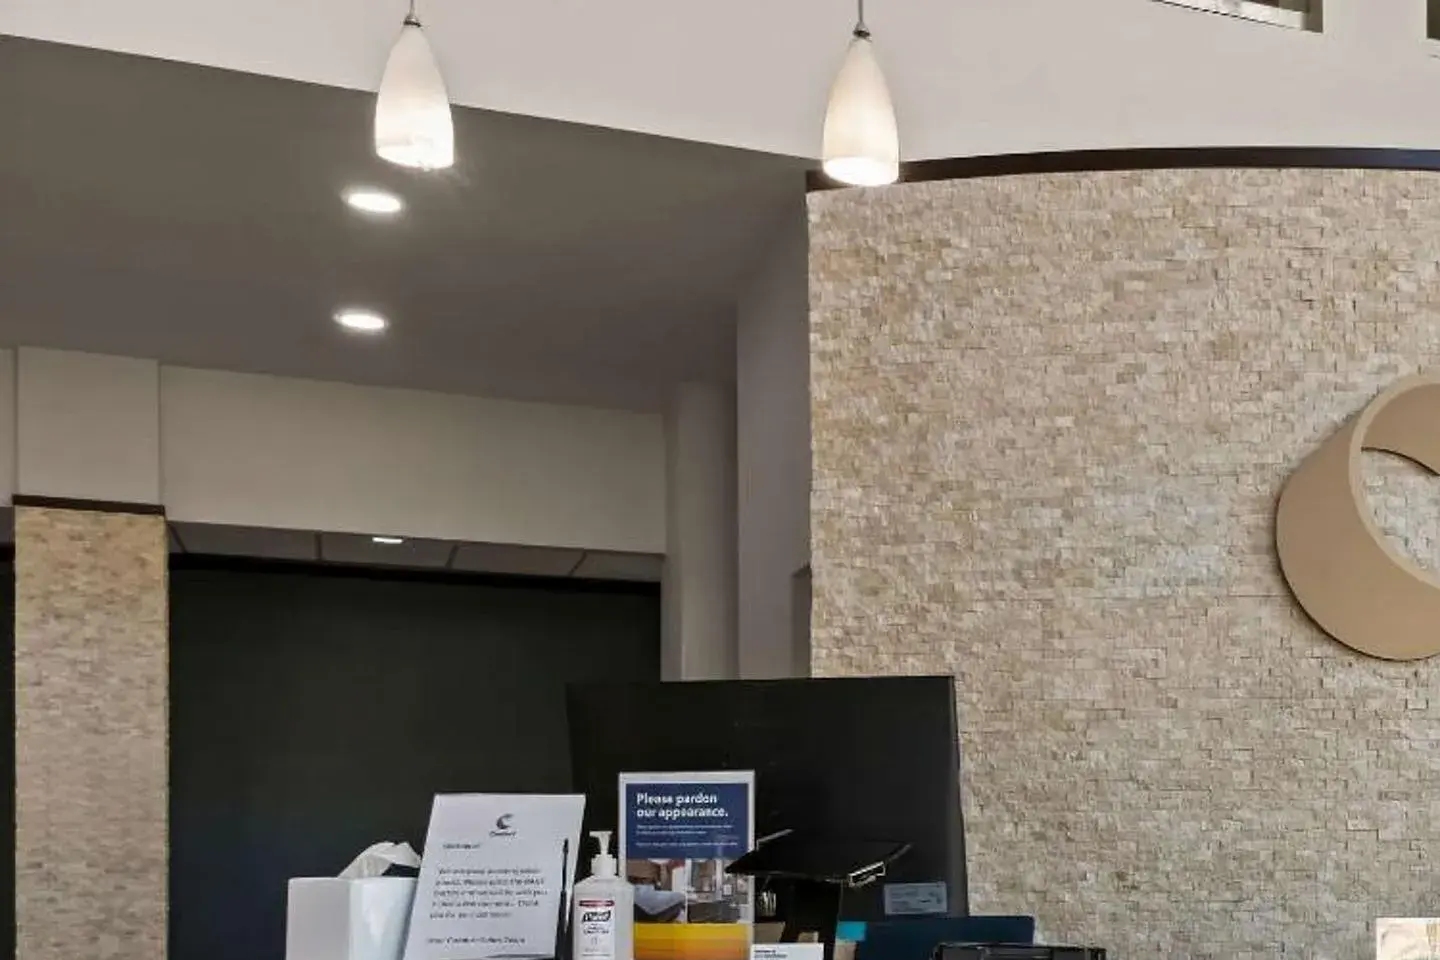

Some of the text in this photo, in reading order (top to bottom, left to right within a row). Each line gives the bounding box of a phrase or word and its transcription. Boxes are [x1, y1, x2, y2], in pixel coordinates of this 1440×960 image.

[636, 792, 717, 806] Please pardon
[636, 807, 729, 820] our appearance.
